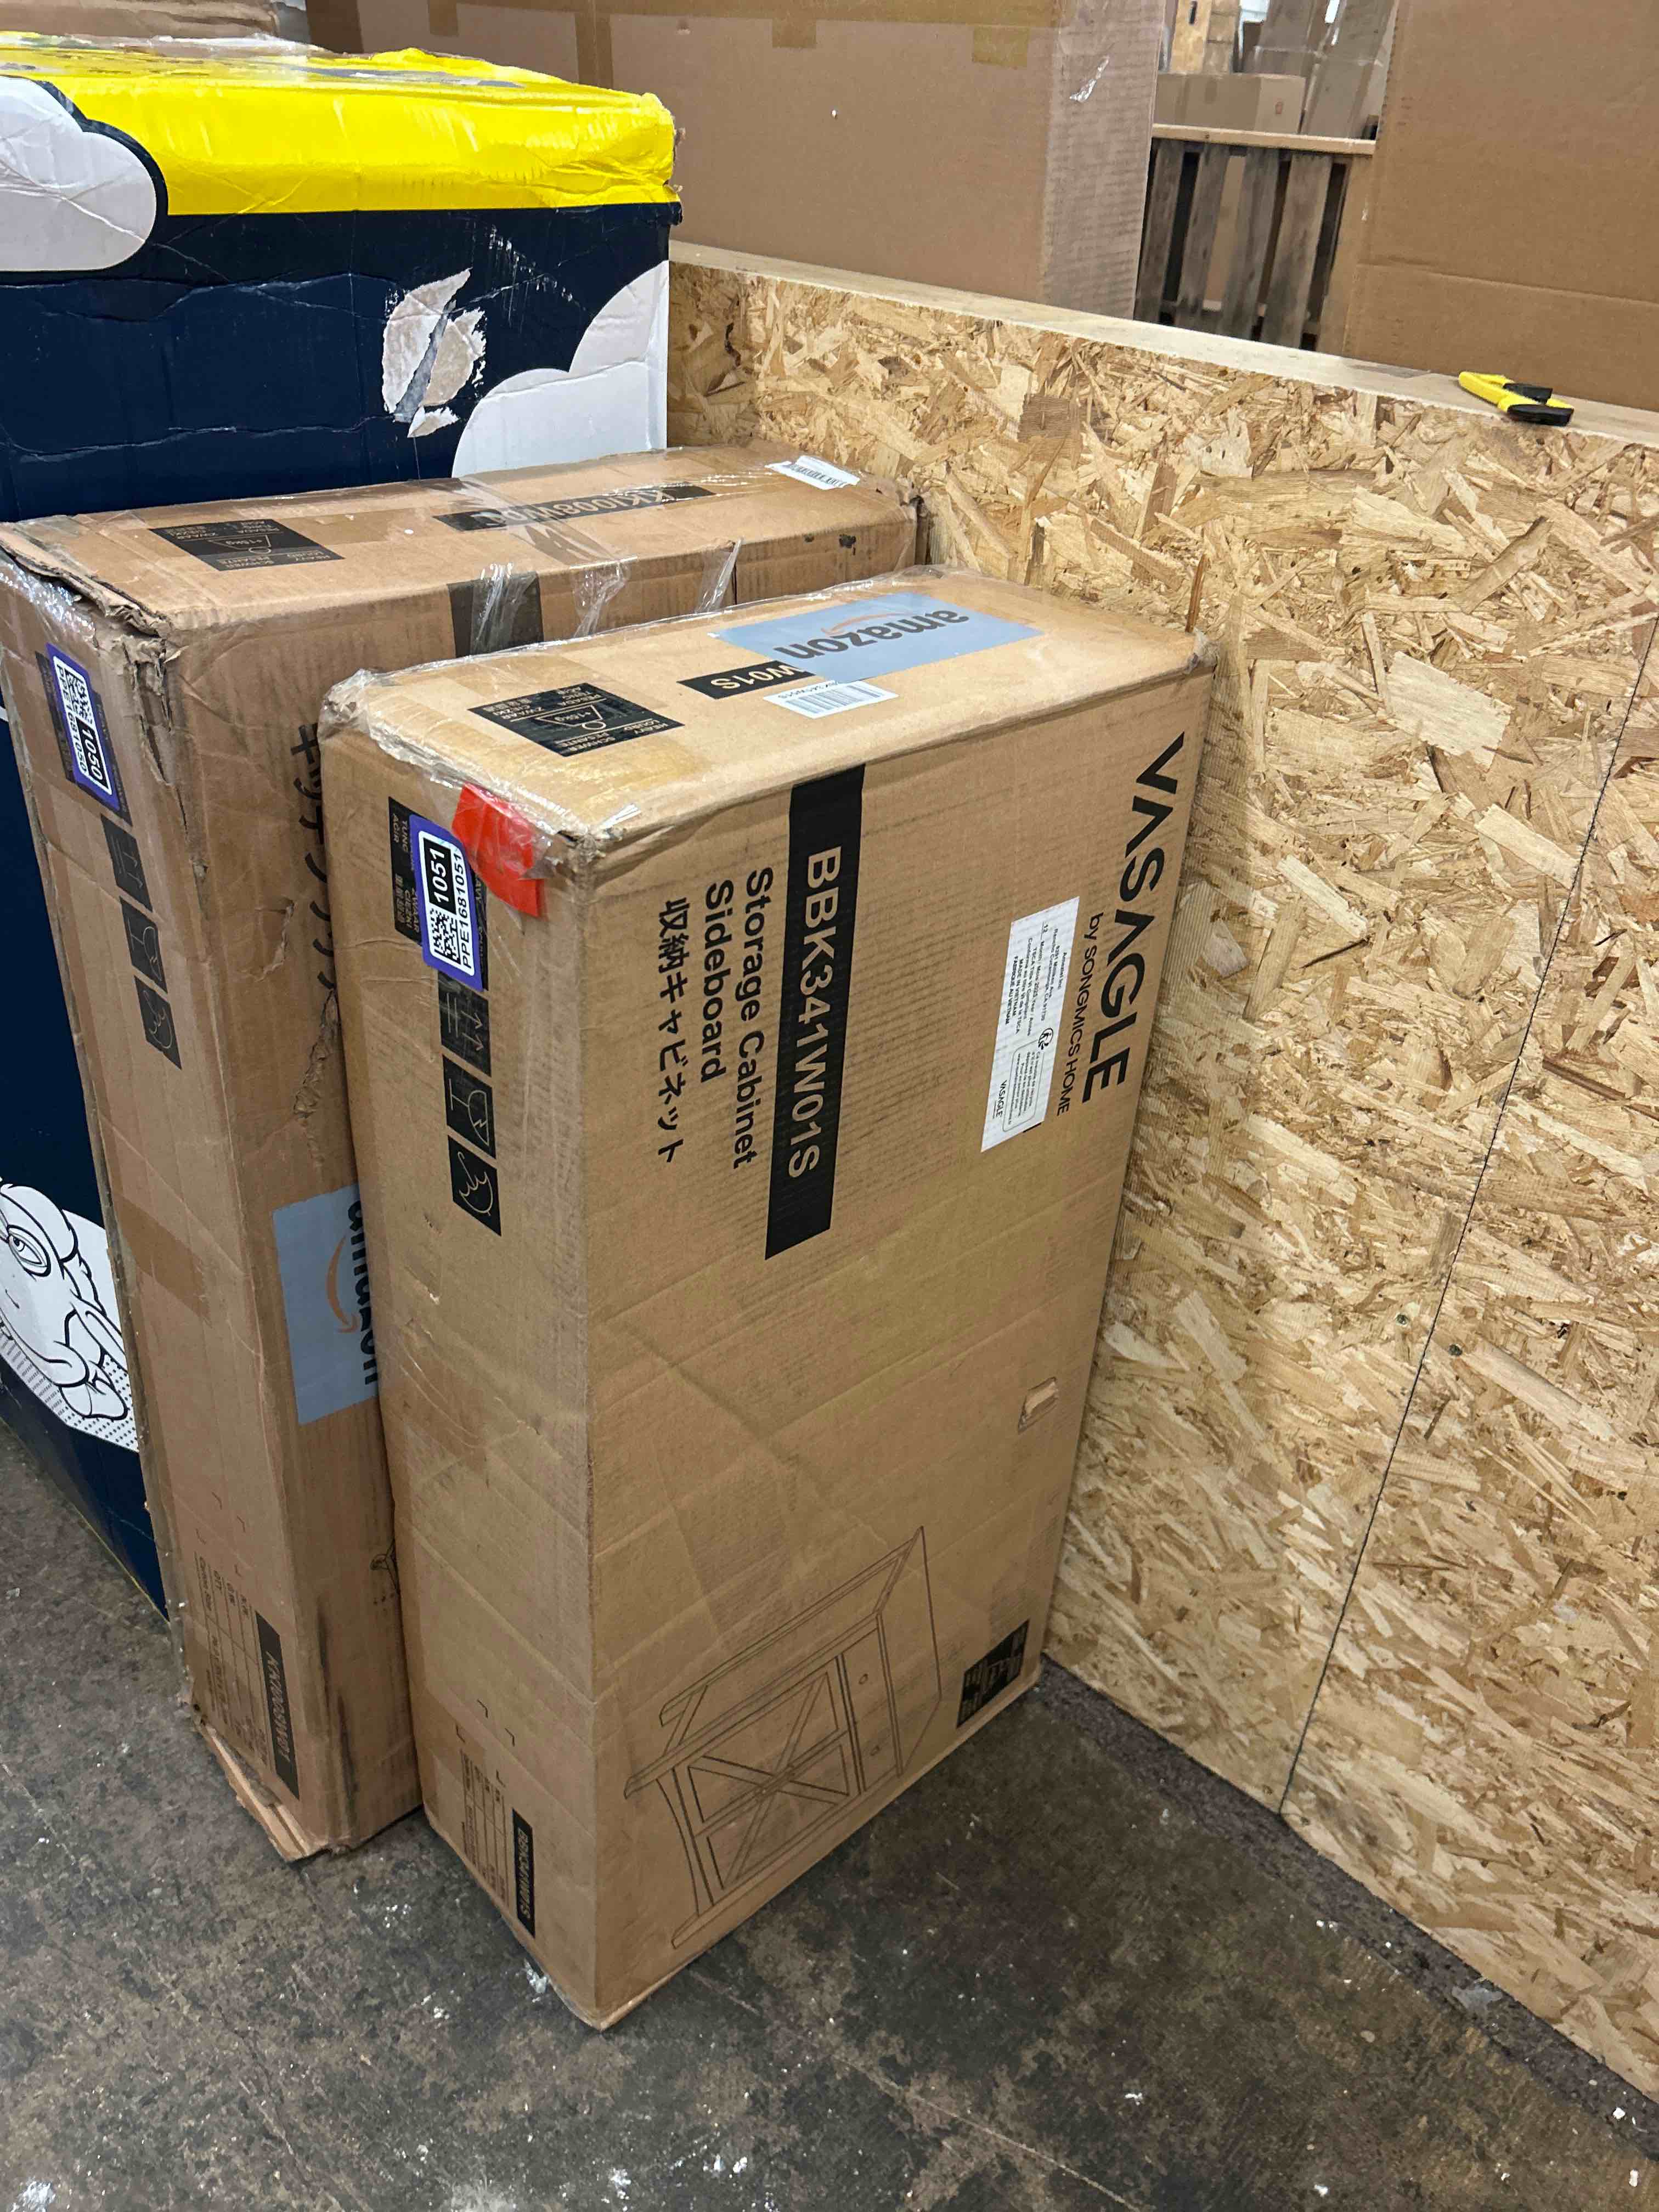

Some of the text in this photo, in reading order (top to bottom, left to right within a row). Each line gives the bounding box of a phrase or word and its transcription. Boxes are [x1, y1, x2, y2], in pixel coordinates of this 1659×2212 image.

[774, 609, 969, 659] amazon
[57, 664, 87, 773] PPE1681050
[82, 729, 102, 778] 1050
[429, 849, 449, 902] 1051
[454, 853, 471, 969] PPE1681051
[1082, 731, 1185, 1103] VASAGLE
[699, 879, 734, 1084] Sideboard
[1024, 937, 1032, 969] Conforme
[657, 898, 691, 1164] 収納キャビネット
[733, 866, 774, 1170] Storage Cabinet
[788, 845, 842, 1178] BBK341W01S
[1005, 997, 1013, 1025] VIETNAM
[1057, 912, 1104, 1116] by SONGMICS HOME
[996, 1079, 1007, 1118] VASAGLE
